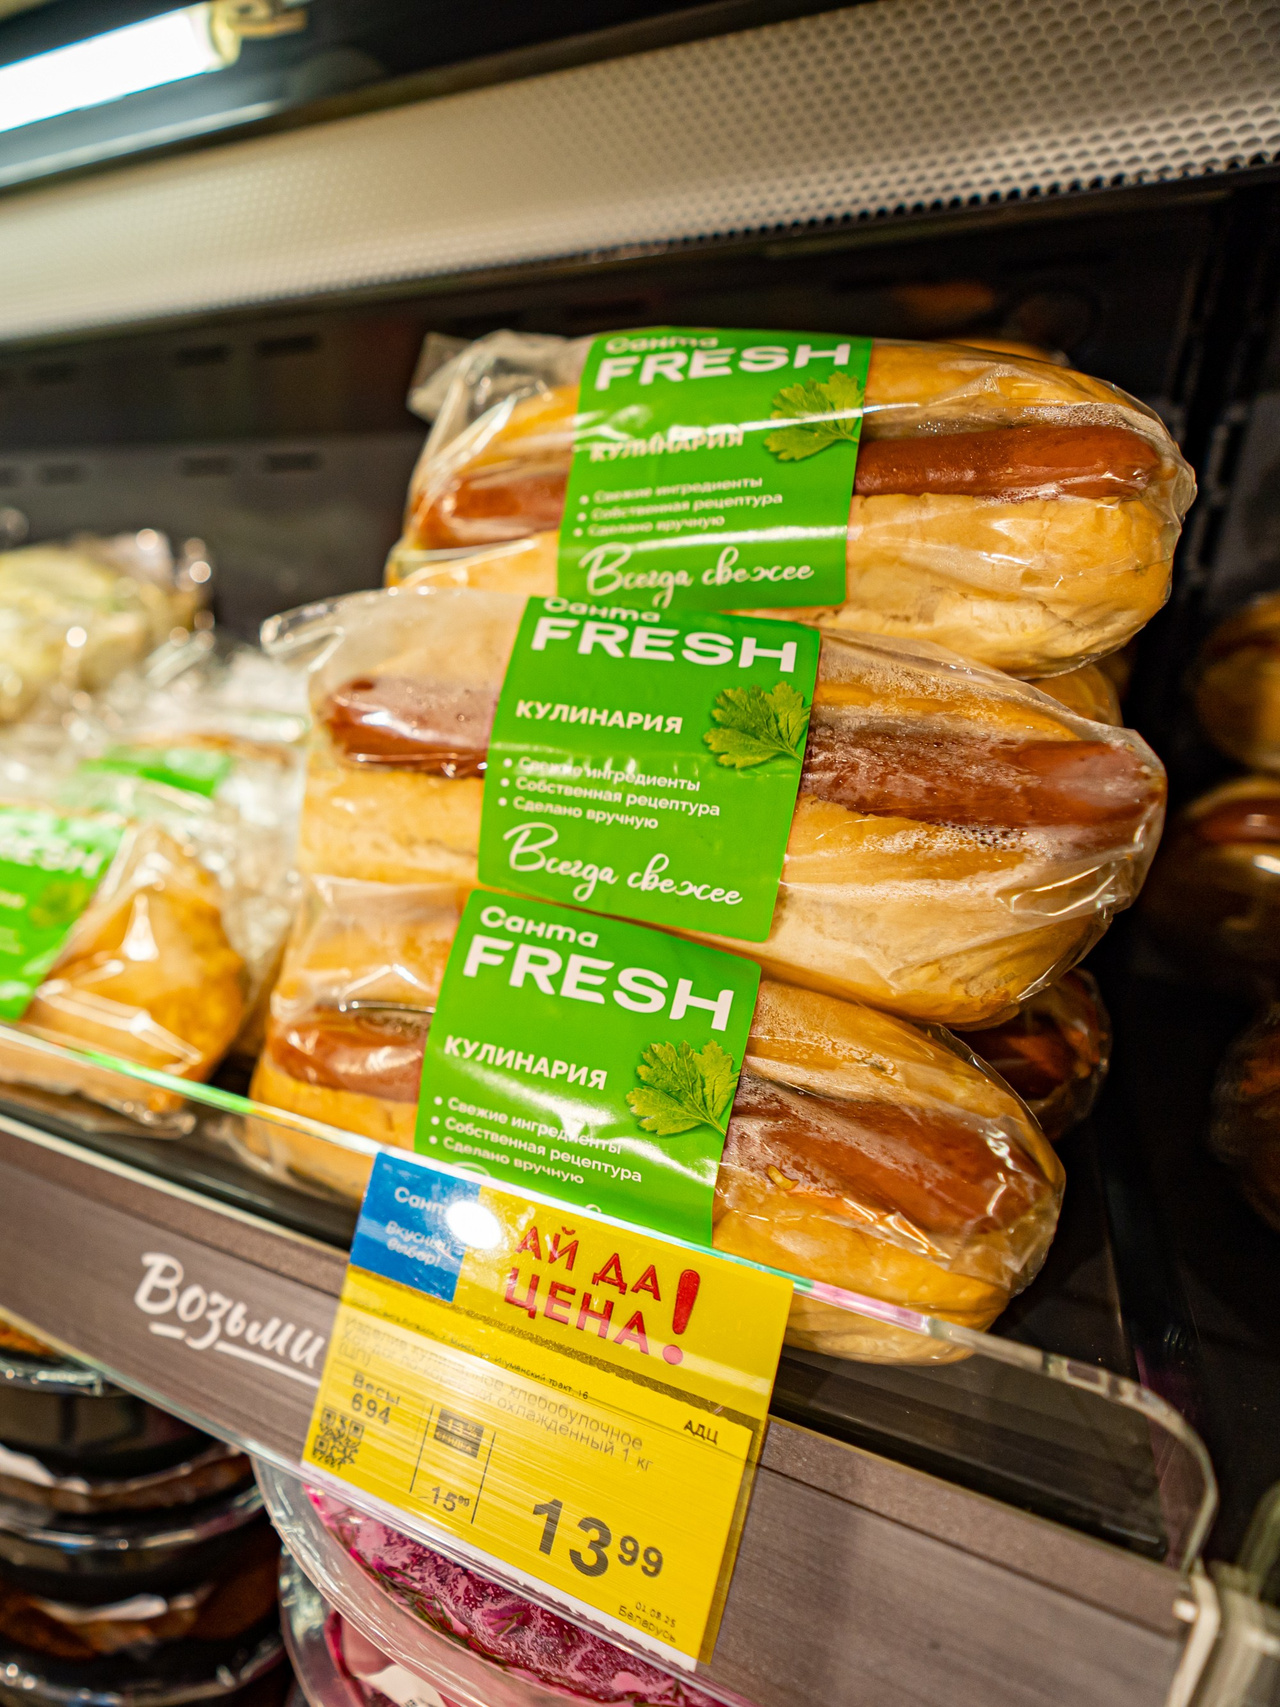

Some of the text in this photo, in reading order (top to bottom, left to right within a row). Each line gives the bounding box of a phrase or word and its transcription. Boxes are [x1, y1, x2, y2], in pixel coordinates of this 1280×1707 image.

[595, 344, 851, 391] FRESH
[591, 493, 783, 521] Собственная рецептура
[656, 477, 762, 500] ингредиенты
[588, 515, 725, 537] Сделано вручную
[579, 542, 814, 608] Всегда свежее
[544, 596, 660, 623] Санта
[531, 616, 797, 673] FRESH
[516, 700, 683, 734] КУЛИНАРИЯ
[515, 777, 720, 817] Собственная рецептура
[586, 766, 700, 792] ингредиенты
[513, 797, 658, 830] Сделано вручную
[503, 822, 743, 905] Всегда свежее
[480, 906, 599, 948] Санта
[462, 934, 734, 1032] FRESH
[444, 1035, 607, 1090] КУЛИНАРИЯ
[447, 1097, 622, 1155] Свежие ингредиенты
[442, 1136, 511, 1165] Сделано
[514, 1157, 585, 1185] вручную
[444, 1117, 643, 1183] Собственная рецептура
[515, 1225, 661, 1301] АЙ ДА
[134, 1252, 325, 1369] Возьми
[352, 1393, 391, 1425] 694
[353, 1372, 400, 1405] Весы
[498, 1397, 615, 1457] охлажденный
[637, 1458, 653, 1471] кг
[509, 1383, 643, 1450] хлебобулочное
[684, 1419, 718, 1445] АДЦ
[618, 1604, 677, 1643] Беларусь
